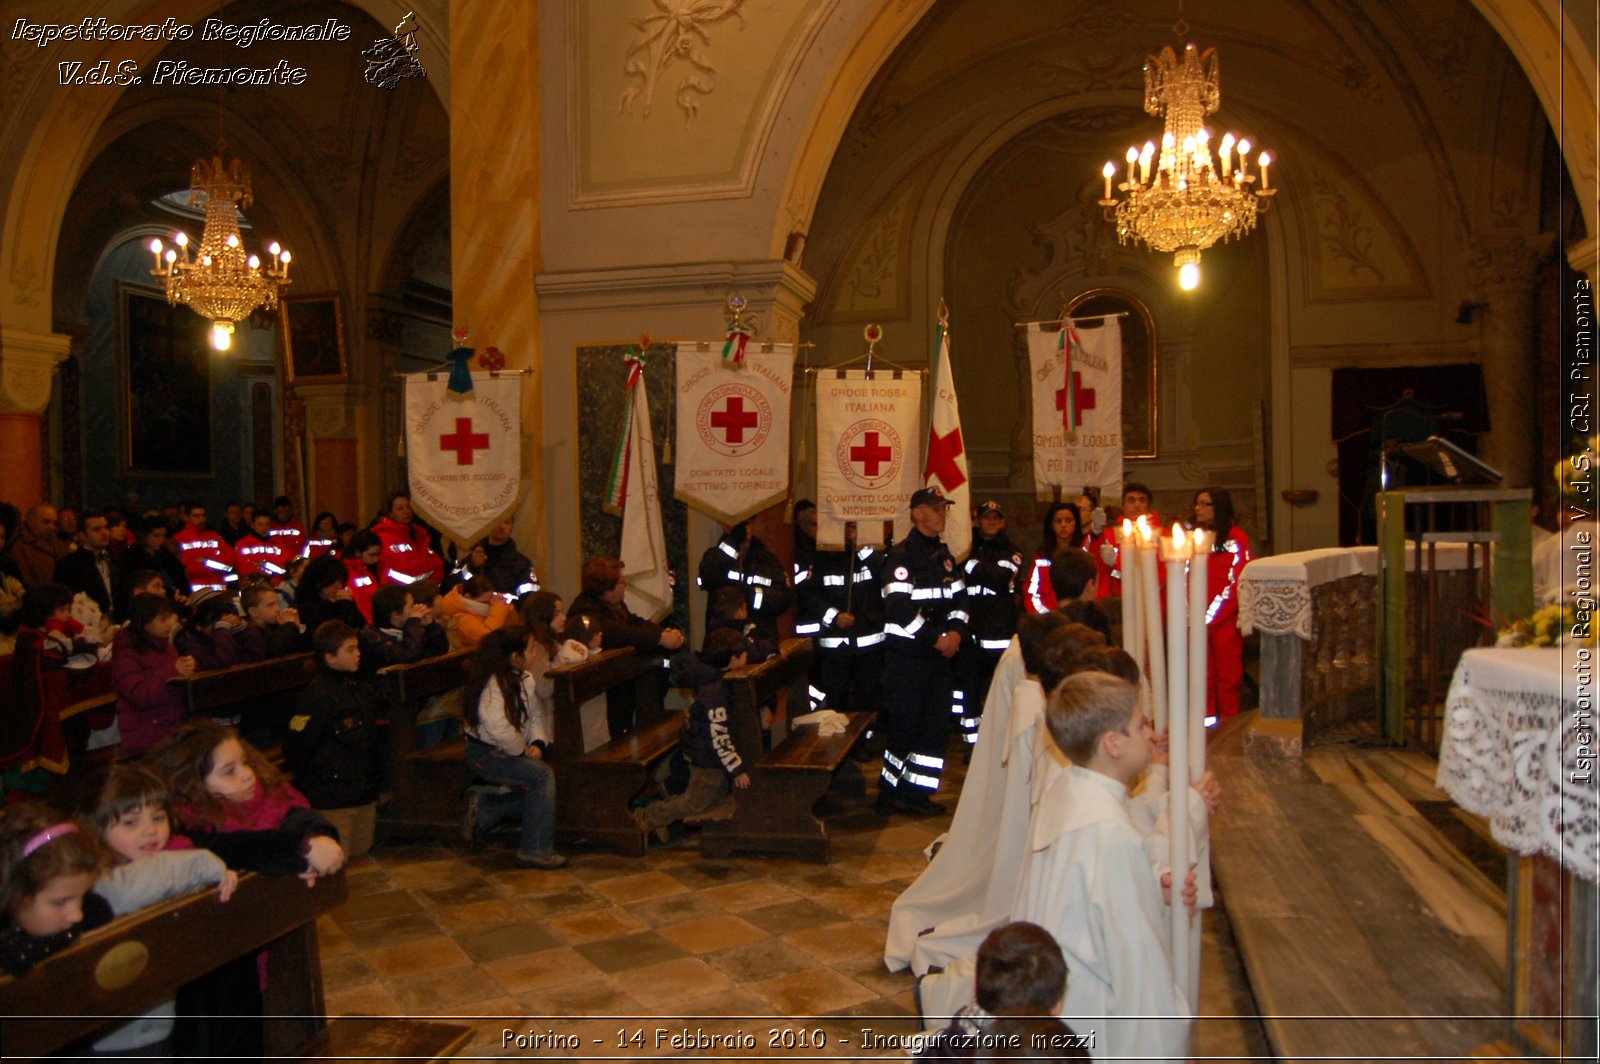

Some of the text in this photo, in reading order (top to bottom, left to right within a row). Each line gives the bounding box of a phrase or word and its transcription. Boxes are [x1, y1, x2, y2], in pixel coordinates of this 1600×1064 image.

[830, 388, 908, 398] CROCE ROSSA
[844, 403, 896, 413] ITALIANA
[689, 467, 775, 477] COMITATO LOCALE
[684, 481, 782, 491] SETTIMO TORINESE
[825, 494, 875, 504] COMITATO
[426, 496, 480, 516] FRANCESCO
[842, 505, 896, 515] NICHELINO
